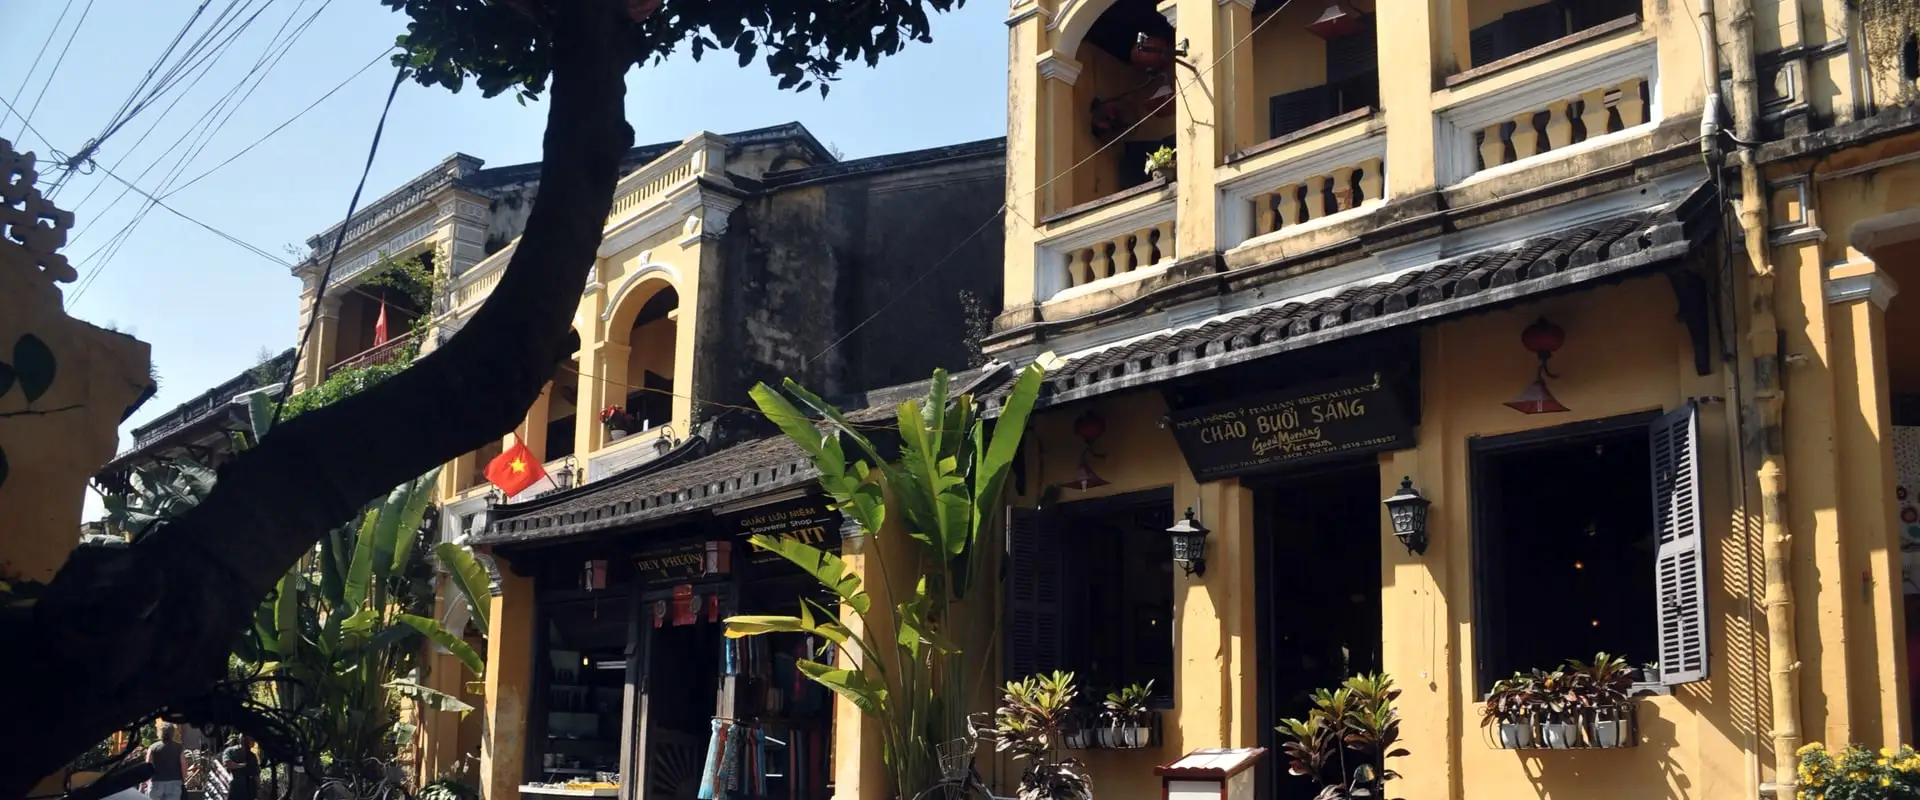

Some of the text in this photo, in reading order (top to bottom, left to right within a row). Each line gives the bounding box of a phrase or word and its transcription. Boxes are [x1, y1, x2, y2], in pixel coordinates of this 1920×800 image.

[1248, 399, 1295, 416] ITALIAN
[1298, 383, 1379, 405] RESTAURANT
[1311, 398, 1365, 423] SÁNG
[1252, 426, 1321, 456] Good Morning
[750, 517, 813, 533] Souvenir Shop
[637, 559, 660, 571] DUY
